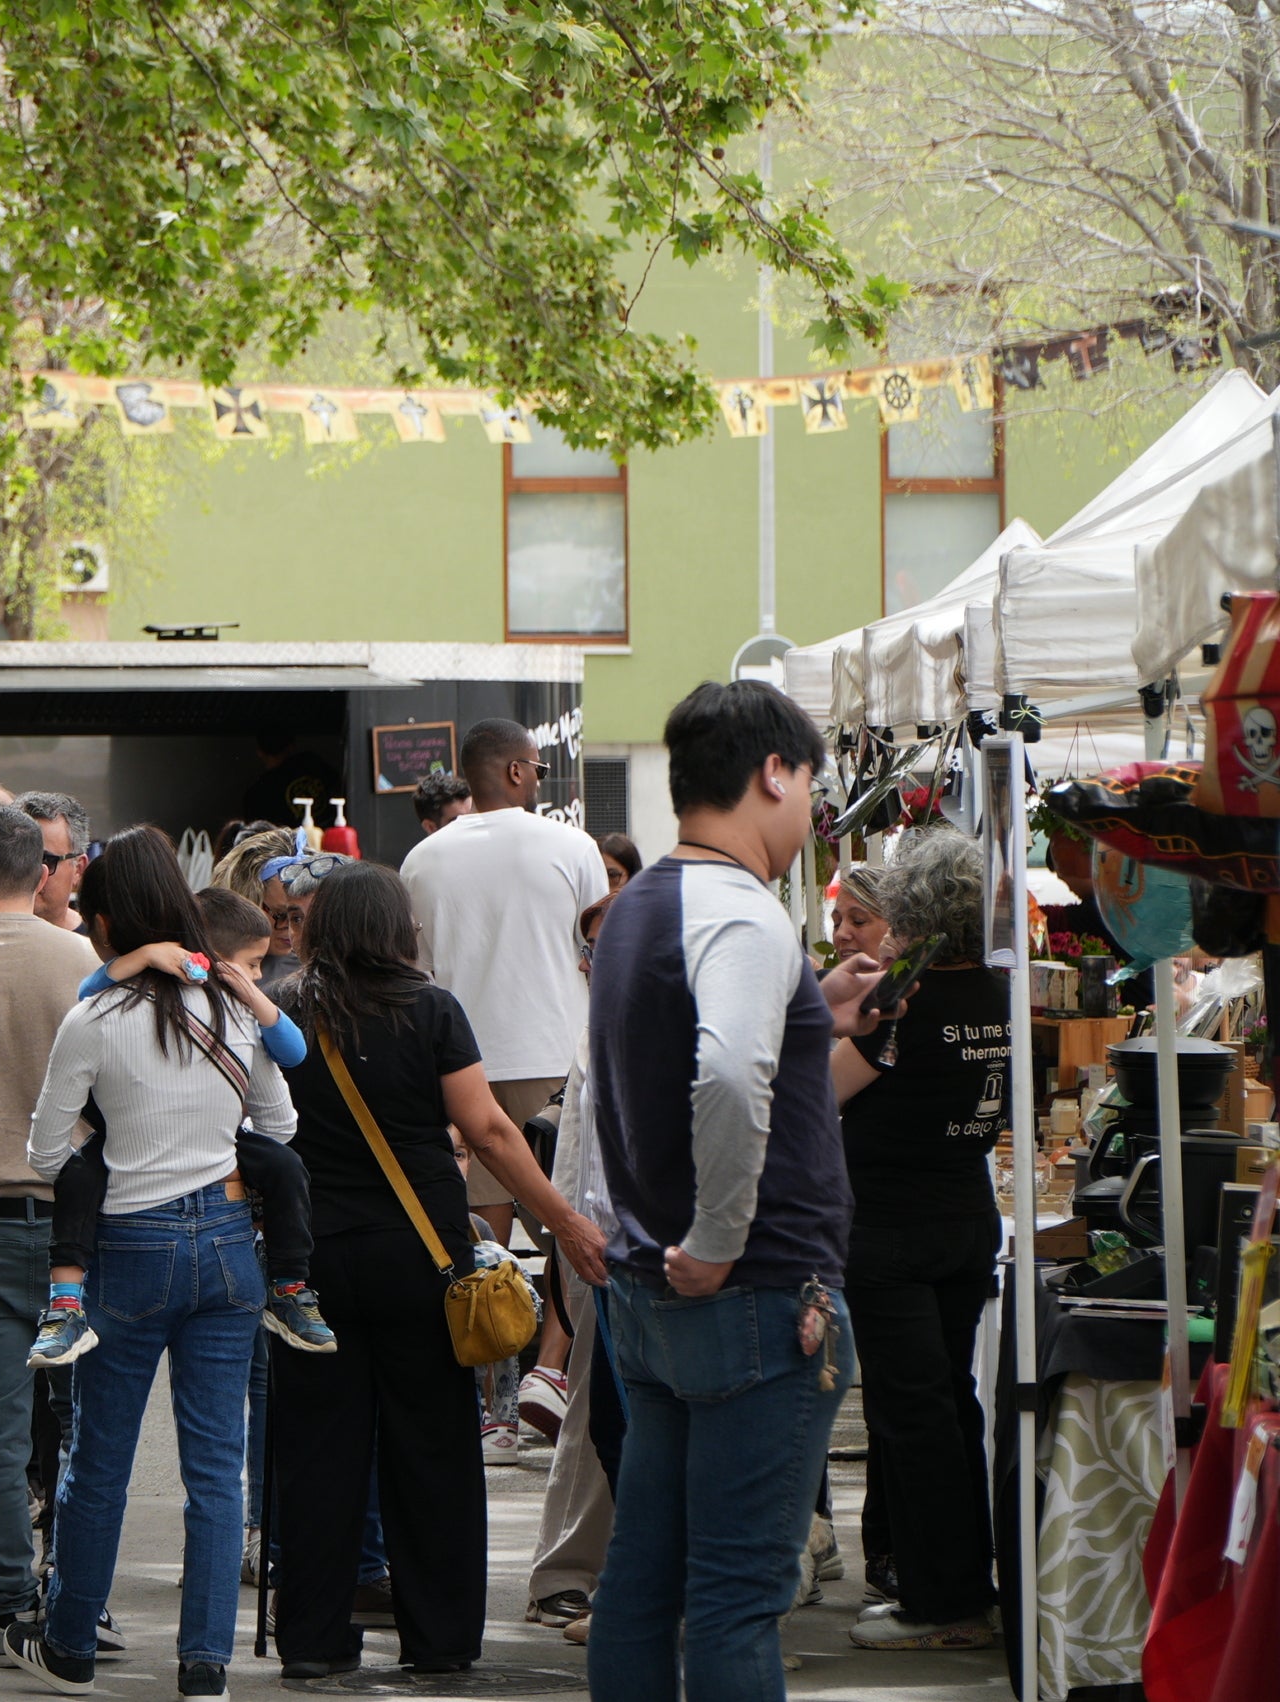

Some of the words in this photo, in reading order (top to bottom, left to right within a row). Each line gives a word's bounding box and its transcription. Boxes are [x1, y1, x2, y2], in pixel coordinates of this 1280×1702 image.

[943, 1024, 961, 1043] Si
[964, 1025, 981, 1042] tu
[983, 1025, 1003, 1039] me
[946, 1121, 960, 1137] lo
